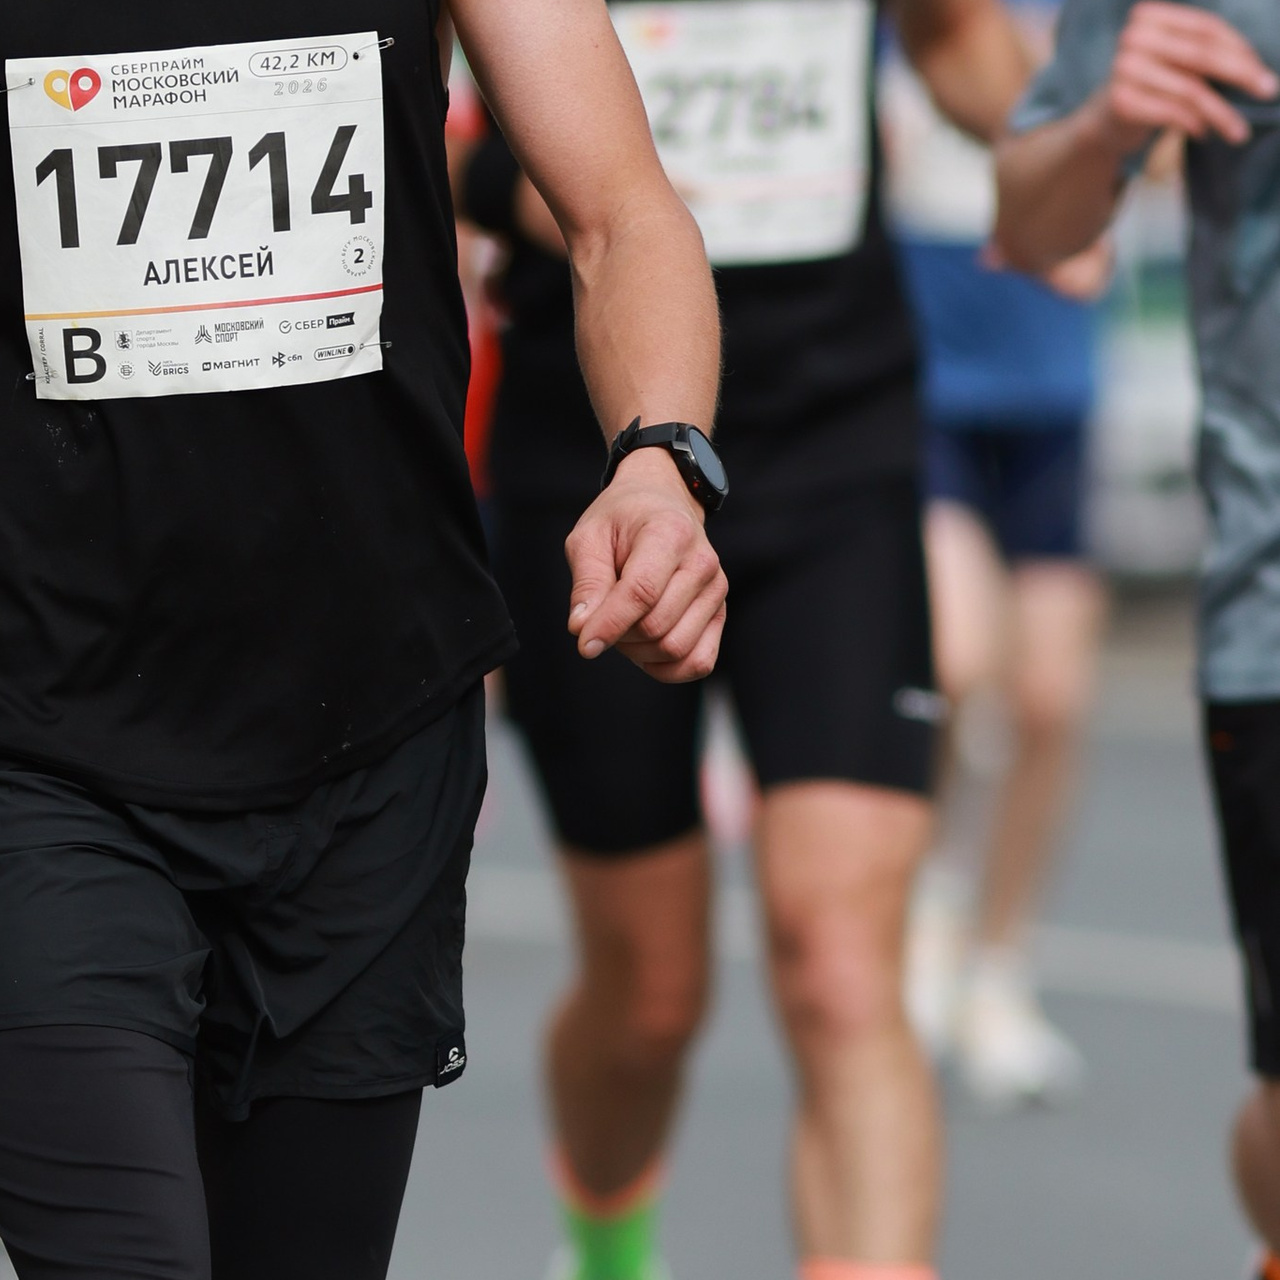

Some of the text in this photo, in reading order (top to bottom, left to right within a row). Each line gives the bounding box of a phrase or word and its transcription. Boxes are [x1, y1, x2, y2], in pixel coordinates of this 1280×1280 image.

[111, 57, 205, 76] СБЕРПРАЙМ
[260, 54, 299, 72] 42,2
[112, 67, 239, 93] МОСКОВСКИЙ
[273, 77, 328, 96] 2026
[113, 89, 207, 110] МАРАФОН
[35, 124, 373, 249] 17714
[354, 247, 364, 264] 2
[143, 245, 274, 287] АЛЕКСЕЙ
[214, 317, 264, 333] МОСКОВСКИЙ
[294, 319, 324, 331] СБЕР
[215, 332, 238, 343] СПОРТ
[317, 347, 346, 358] WINLINE
[163, 367, 189, 376] BRICS
[213, 358, 260, 370] магнит
